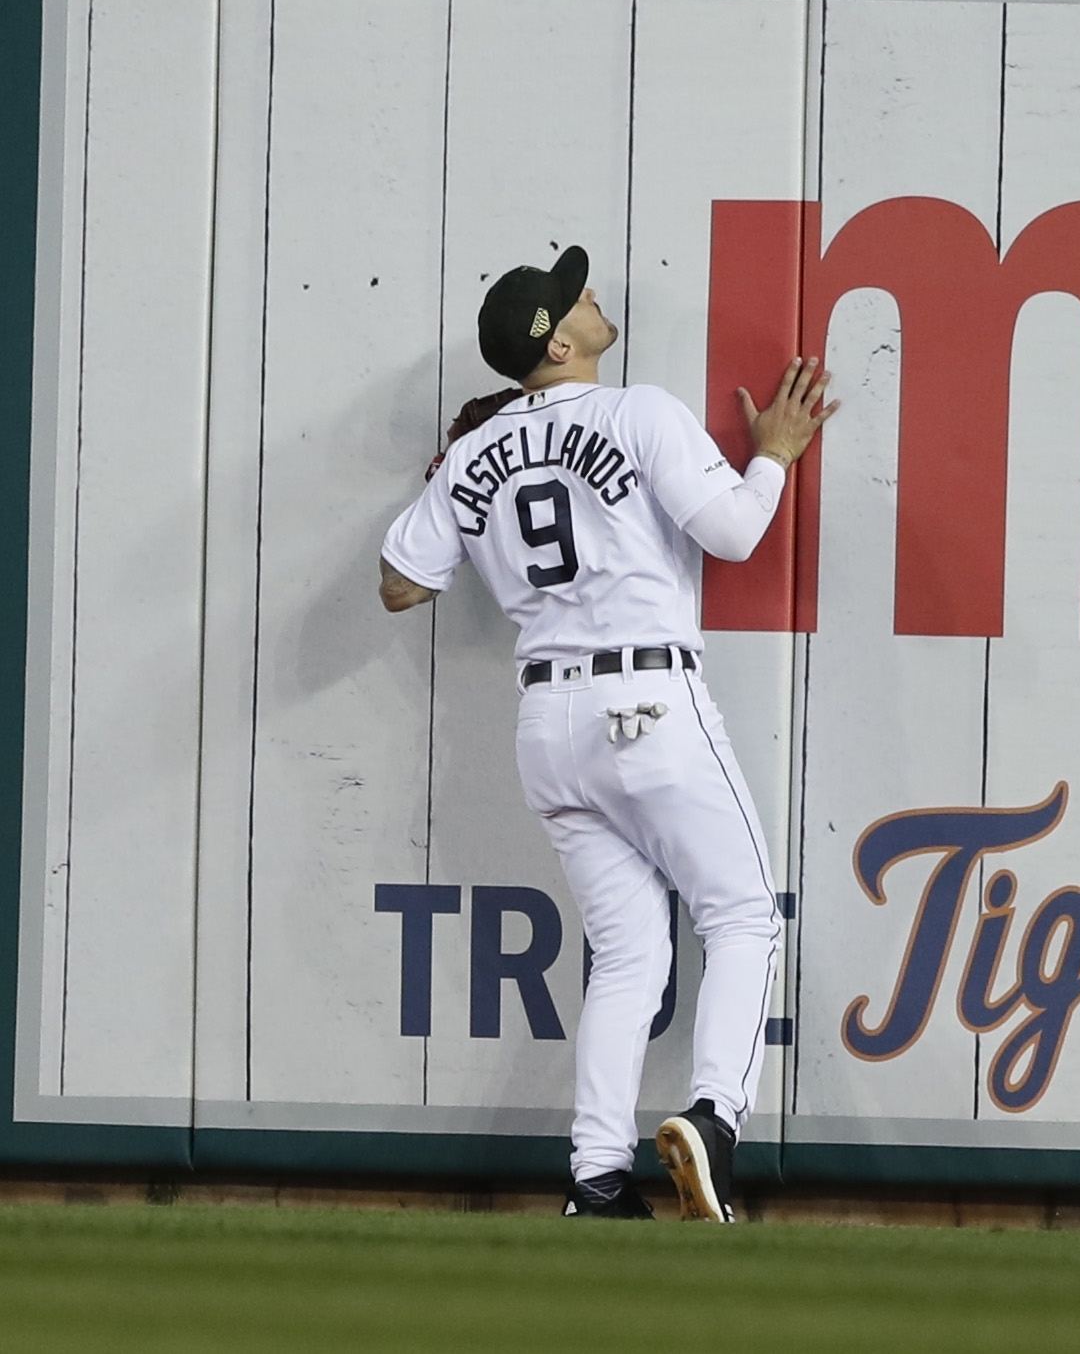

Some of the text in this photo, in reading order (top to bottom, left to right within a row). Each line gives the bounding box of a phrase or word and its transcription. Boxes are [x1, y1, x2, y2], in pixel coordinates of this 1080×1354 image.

[450, 422, 638, 537] CASTELLANOS
[515, 479, 579, 588] 9
[374, 883, 797, 1046] TR
